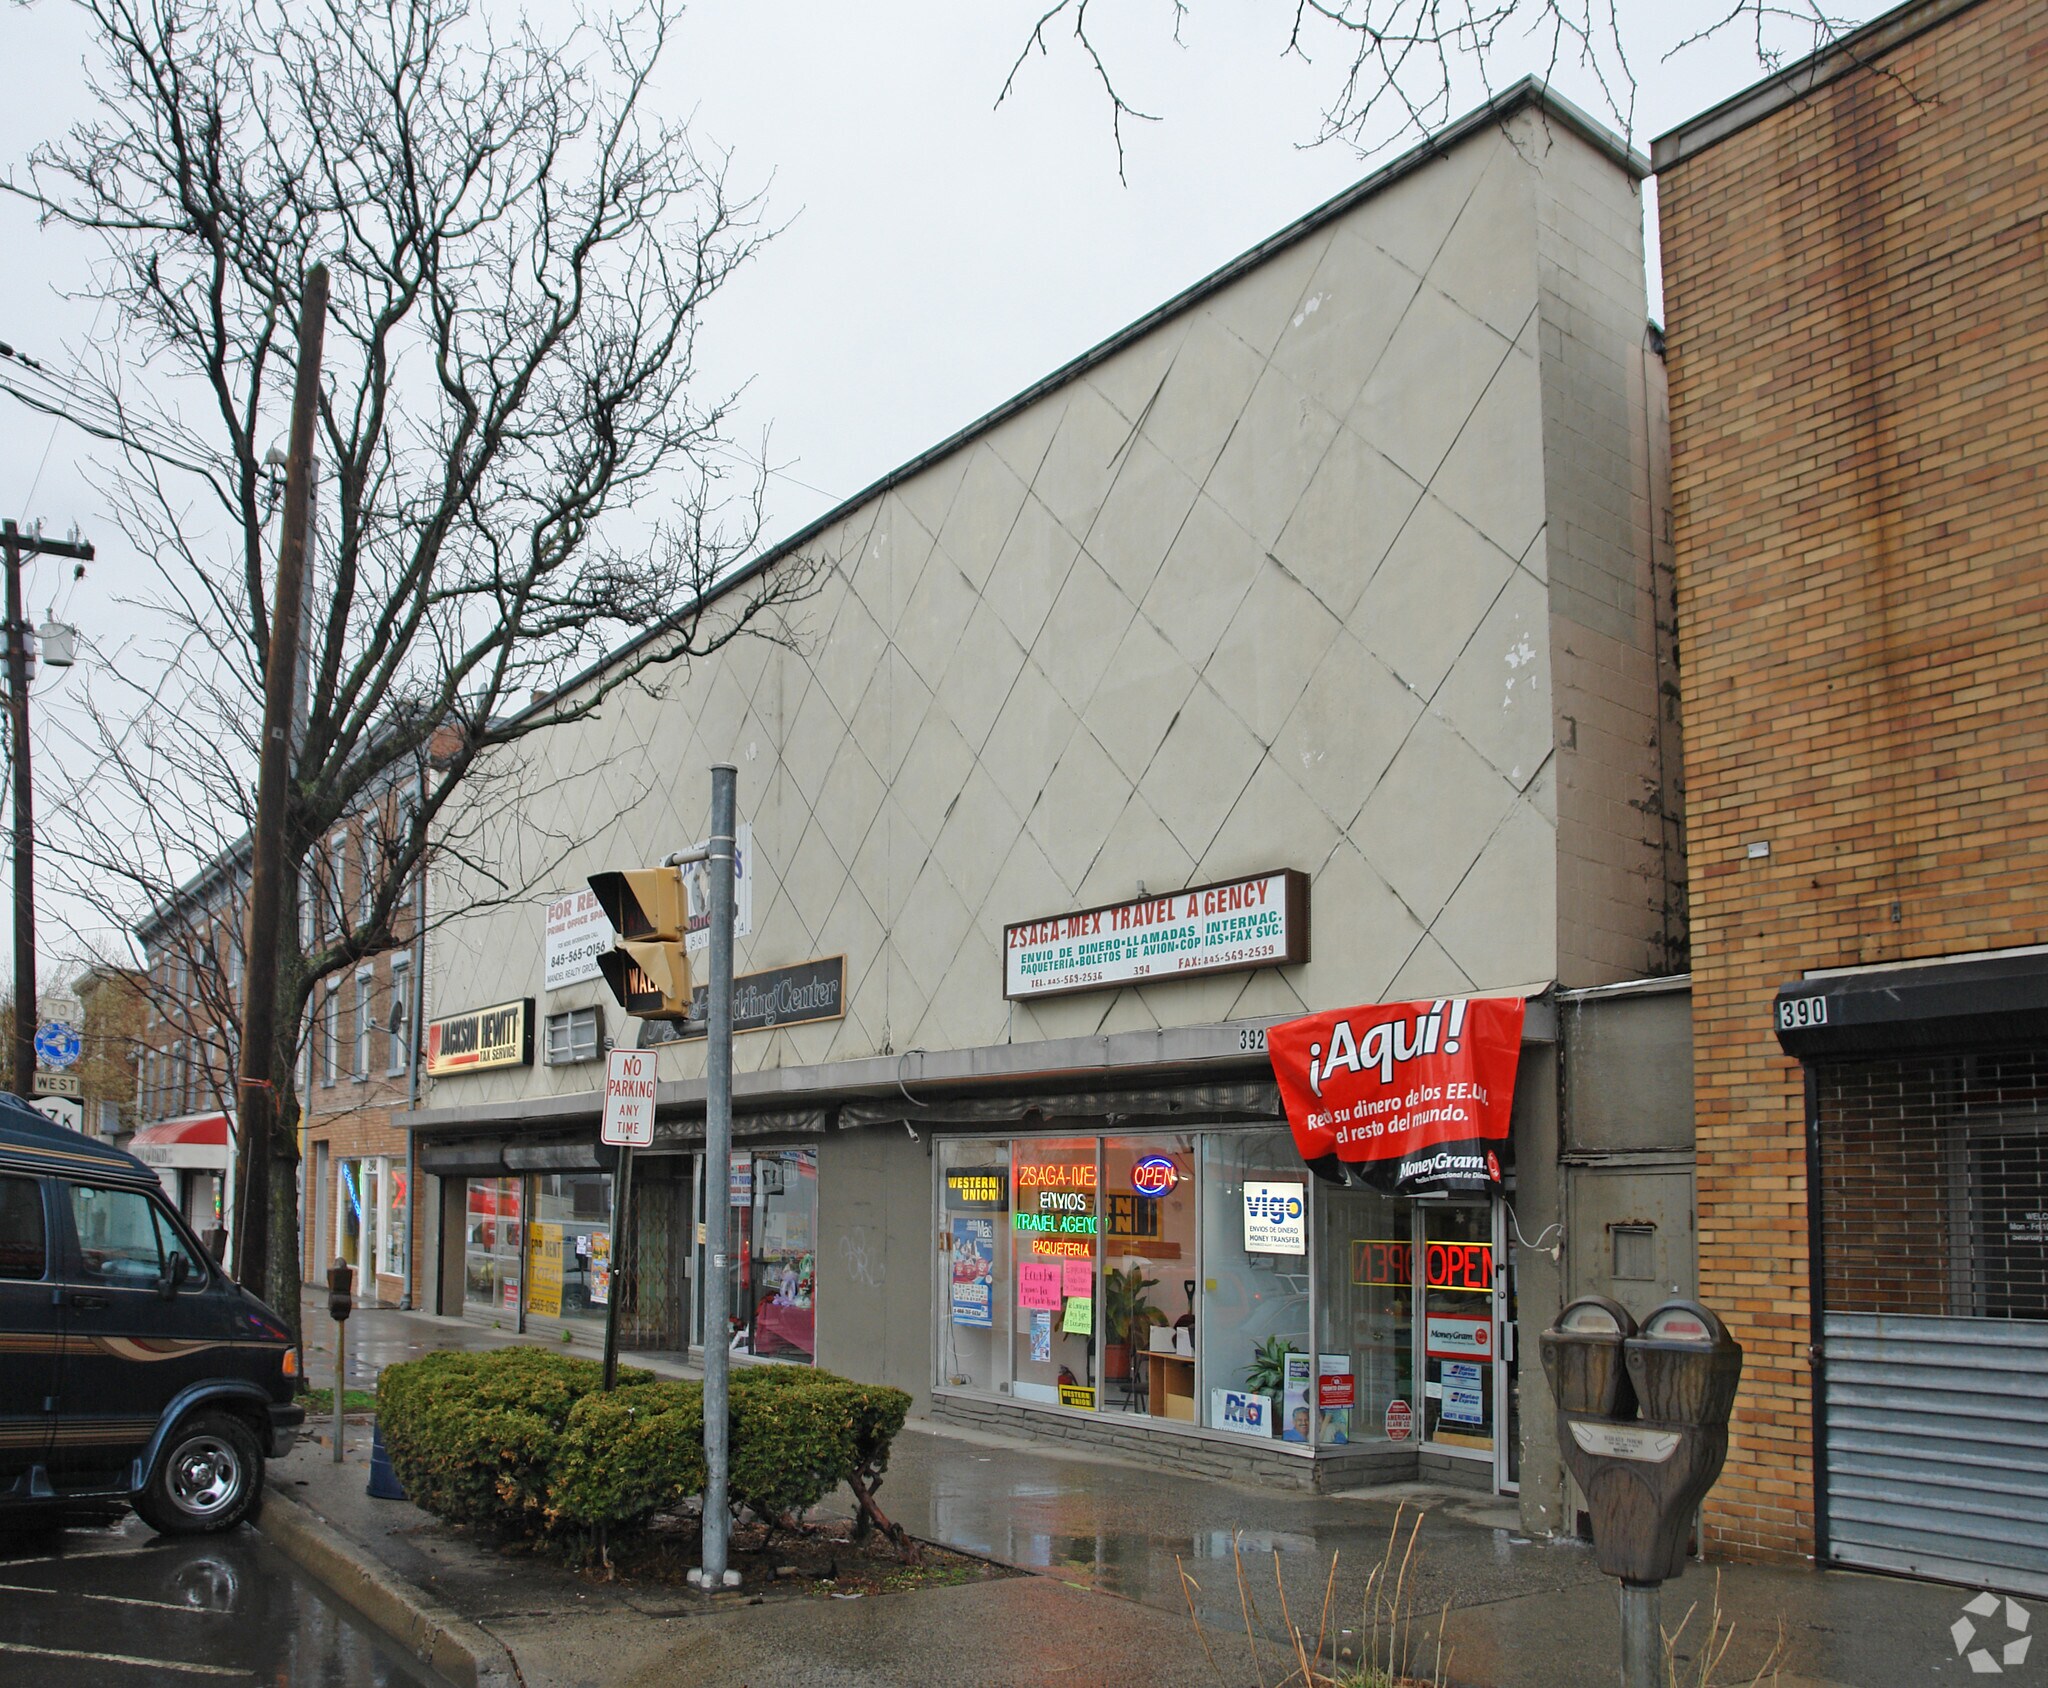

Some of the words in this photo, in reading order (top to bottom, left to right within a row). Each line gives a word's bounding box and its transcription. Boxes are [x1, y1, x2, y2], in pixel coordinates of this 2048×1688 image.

[548, 899, 572, 924] FOR
[547, 922, 565, 936] PRIME
[567, 914, 588, 930] OFFICE
[590, 908, 607, 922] SPAC
[1009, 912, 1102, 949] ZSAGA-MEX
[1111, 898, 1176, 932] TRAVEL
[1021, 950, 1053, 964] ENVIO
[1059, 946, 1073, 958] DE
[1206, 910, 1282, 934] INTERNAC.
[1126, 947, 1138, 959] DE
[1256, 923, 1283, 939] SVC.
[551, 940, 606, 968] 845-565-0156
[1134, 964, 1150, 976] 394
[629, 967, 659, 994] WAL
[778, 975, 839, 1013] Center
[48, 1003, 67, 1016] TO
[1783, 998, 1824, 1027] 390
[440, 1016, 479, 1056] JACKSON
[481, 1006, 518, 1049] HEWITT
[1240, 1030, 1264, 1050] 392
[480, 1049, 490, 1062] TAX
[492, 1045, 516, 1061] SERVICE
[1309, 999, 1469, 1098] ¡Aquí!
[623, 1058, 641, 1076] NO
[37, 1076, 75, 1091] WEST
[608, 1079, 653, 1098] PARKING
[619, 1104, 639, 1117] ANY
[1334, 1109, 1350, 1124] su
[1354, 1097, 1401, 1120] dinero
[1405, 1091, 1419, 1106] de
[1420, 1084, 1441, 1102] los
[617, 1122, 640, 1134] TIME
[1336, 1126, 1348, 1144] el
[1351, 1120, 1384, 1141] resto
[1388, 1112, 1410, 1134] del
[1413, 1103, 1469, 1126] mundo.
[948, 1176, 997, 1189] WESTERN
[1134, 1166, 1174, 1186] OPEN
[962, 1188, 997, 1201] UNION
[1039, 1191, 1086, 1211] ENVIOS
[1246, 1188, 1302, 1225] vigo
[1016, 1213, 1058, 1233] TRAVEL
[1249, 1225, 1269, 1233] ENVIOS
[1269, 1226, 1277, 1234] DE
[1278, 1226, 1299, 1235] DINERO
[1032, 1240, 1090, 1258] PAQUETERIA
[1249, 1234, 1269, 1242] MONEY
[1270, 1235, 1300, 1244] TRANSFER
[1430, 1330, 1473, 1341] MoneyGram
[1224, 1393, 1263, 1426] Ria
